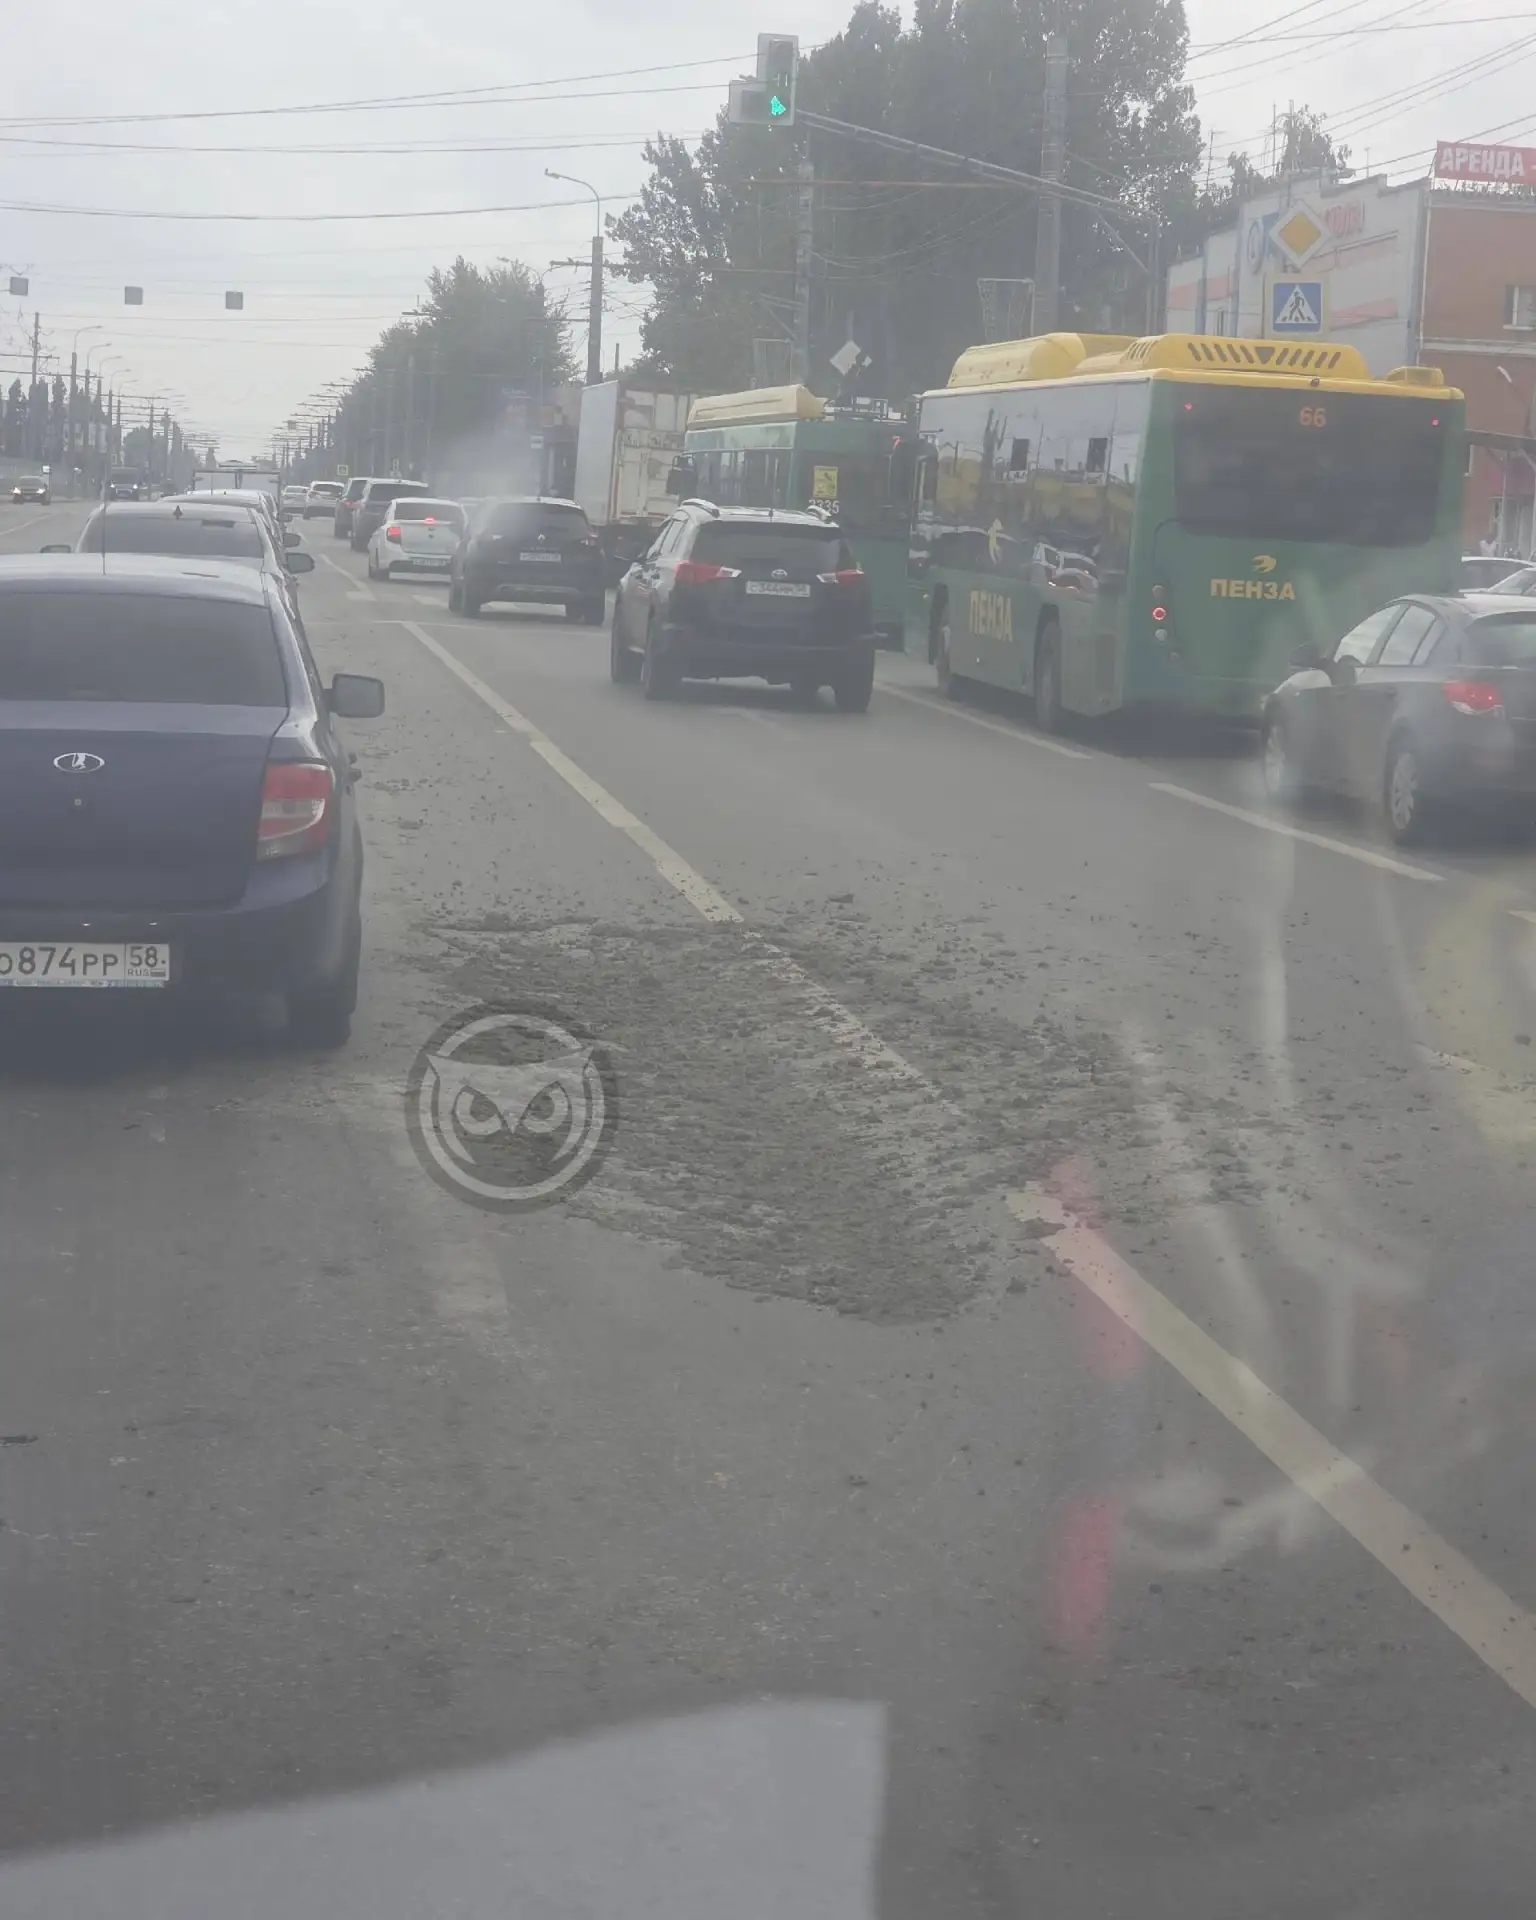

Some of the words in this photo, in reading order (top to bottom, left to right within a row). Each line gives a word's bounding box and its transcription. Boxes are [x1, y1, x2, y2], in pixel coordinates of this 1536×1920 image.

[1440, 147, 1524, 179] АРЕНДА
[1299, 407, 1326, 427] 66
[1210, 579, 1296, 600] ПЕНЗА
[968, 590, 1013, 642] ПЕНЗА
[129, 946, 158, 968] 58
[127, 968, 150, 977] RUS
